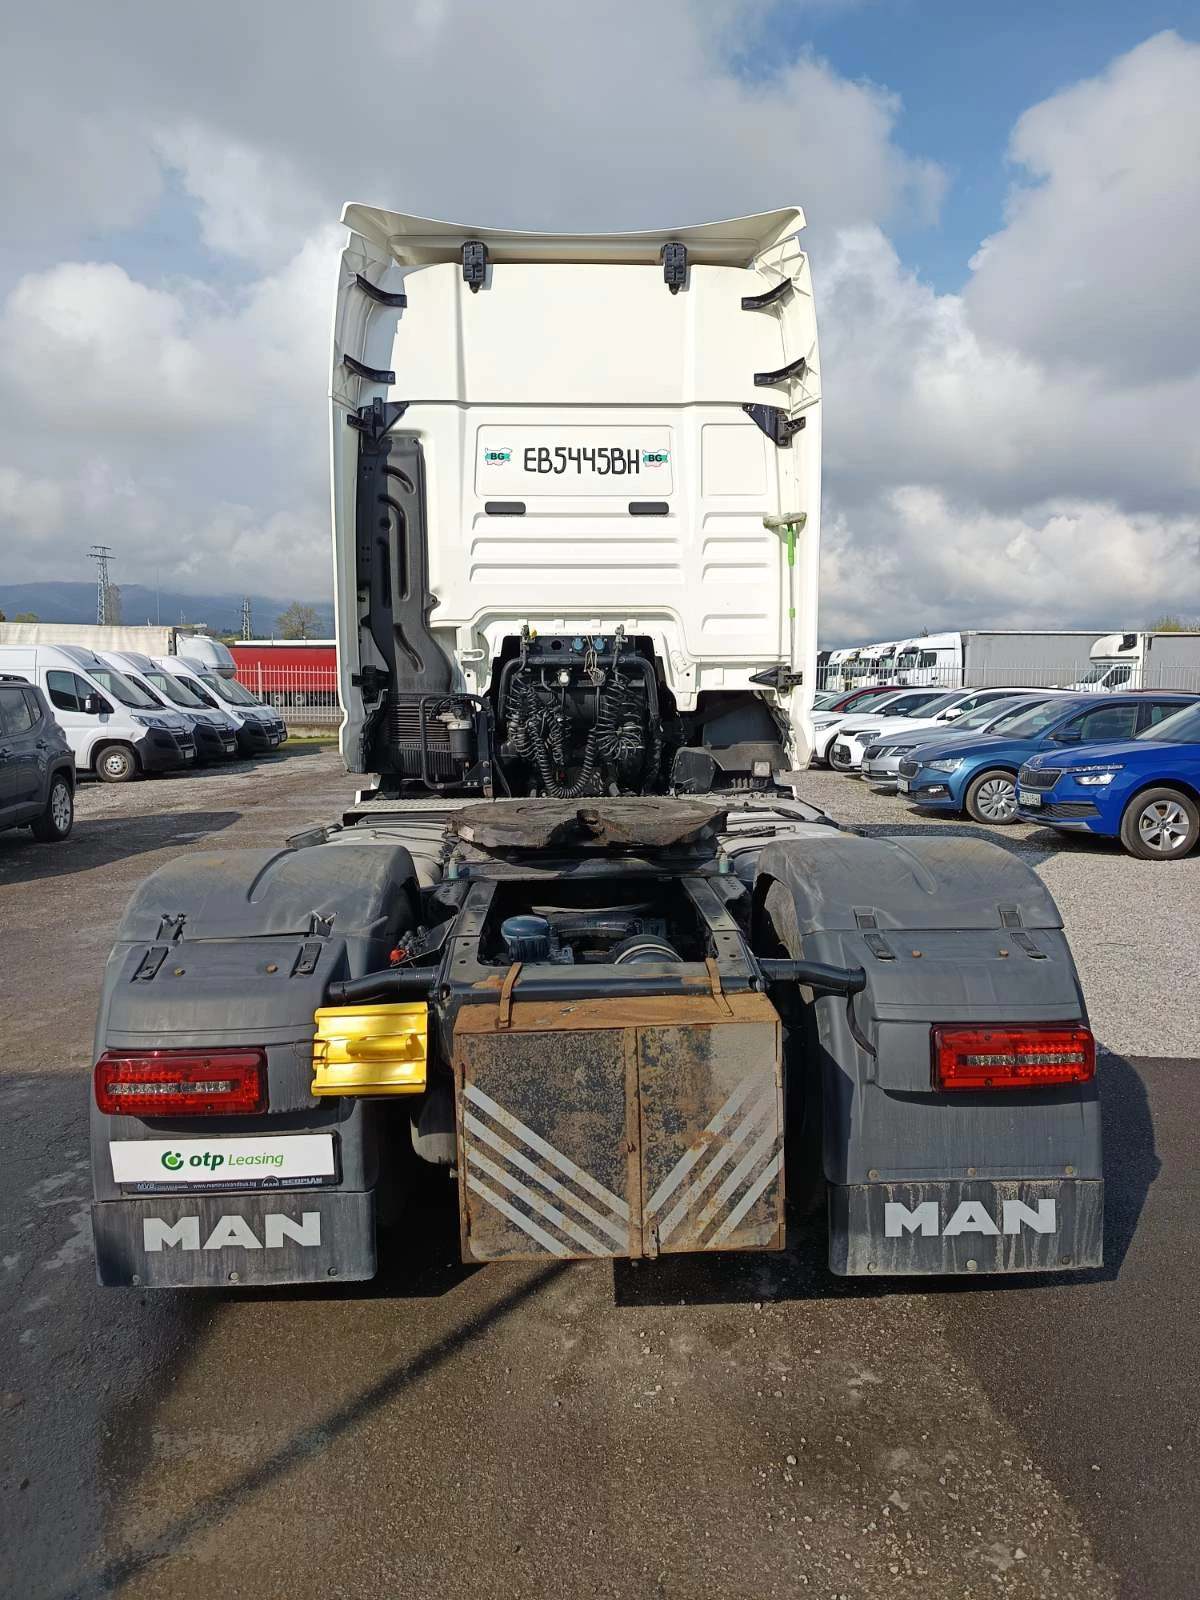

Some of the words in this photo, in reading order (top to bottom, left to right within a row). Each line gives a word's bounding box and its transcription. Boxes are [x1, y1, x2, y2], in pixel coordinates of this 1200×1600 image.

[490, 452, 505, 461] BG
[523, 446, 640, 475] EB5445BH
[648, 454, 663, 462] BG
[189, 1151, 225, 1171] otp
[228, 1153, 284, 1167] Leasing
[884, 1198, 1057, 1238] MAN
[143, 1211, 321, 1252] MAN
